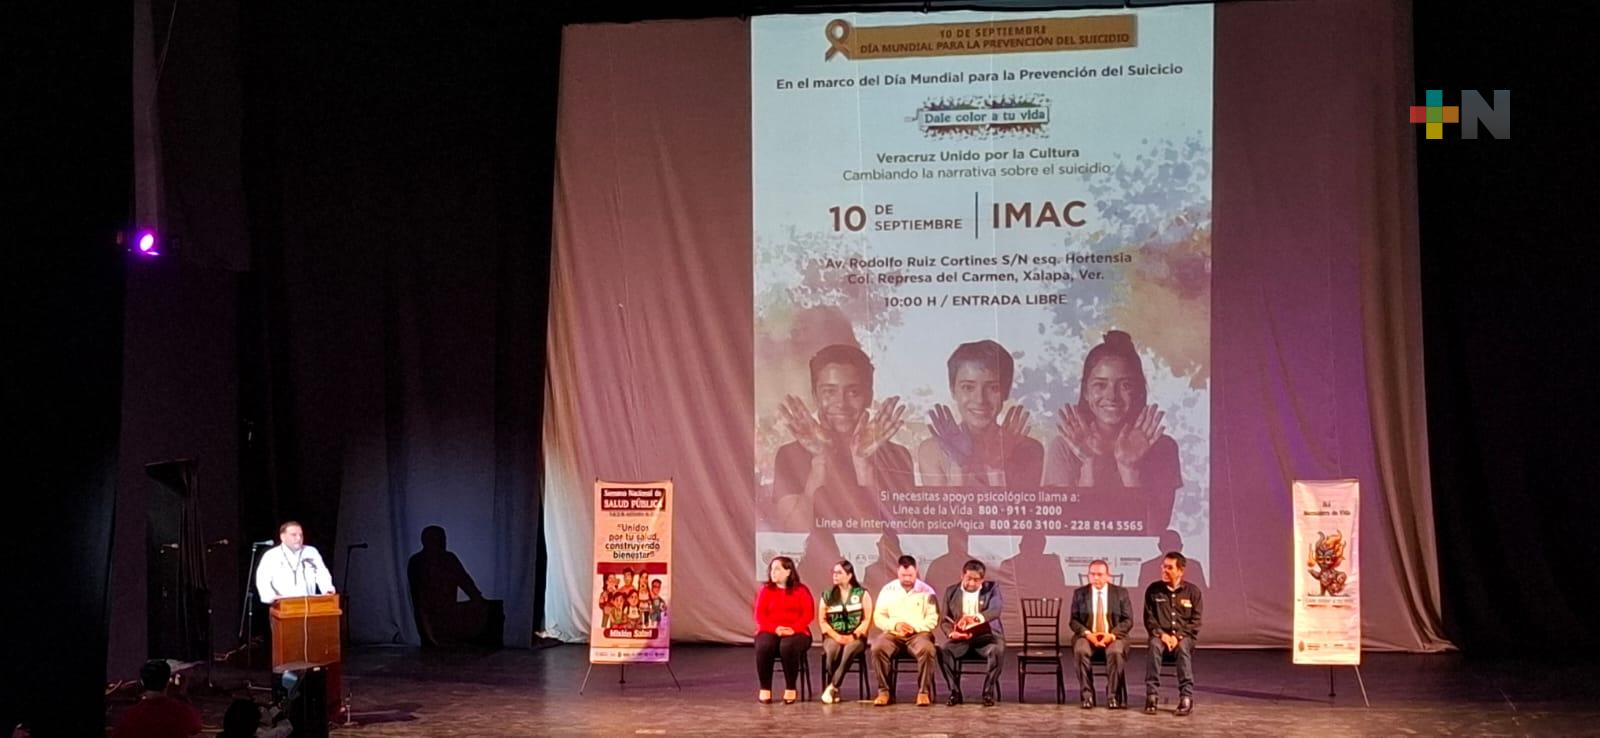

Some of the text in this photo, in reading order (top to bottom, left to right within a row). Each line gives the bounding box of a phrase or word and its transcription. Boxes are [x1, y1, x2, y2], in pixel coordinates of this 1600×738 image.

[940, 25, 1046, 38] 10 DE SEPTIEMBRE
[860, 33, 1130, 54] DÍA MUNDIAL PARA LA PREVENCIÓN DEL SUICIDIO
[776, 78, 793, 90] En
[797, 78, 809, 89] el
[813, 79, 855, 88] marco
[859, 75, 880, 87] del
[884, 74, 906, 86] Día
[911, 72, 964, 84] Mundial
[968, 74, 998, 84] para
[1003, 70, 1015, 81] la
[1020, 66, 1097, 80] Prevención
[1101, 66, 1123, 77] del
[925, 113, 951, 124] Dale
[955, 112, 987, 122] color
[1003, 110, 1016, 120] tu
[1020, 109, 1046, 120] vida
[876, 147, 1080, 164] Veracruz Unido por la Cultura
[842, 162, 1111, 181] Cambiando la narrativa sobre el suicidio
[874, 204, 894, 215] DE
[992, 200, 1087, 229] IMAC
[829, 205, 867, 232] 10
[874, 218, 963, 232] SEPTIEMBRE
[826, 252, 1132, 269] Av. Rodolfo Ruiz Cortines S/N esq. Hortensia
[847, 270, 1104, 286] Col. Represa del Carmen, Xalapa, Ver.
[884, 294, 1068, 308] 10:00 H / ENTRADA LIBRE
[880, 490, 1080, 504] Si necesitas apoyo psicológico llama a:
[923, 504, 936, 515] de
[938, 504, 948, 515] la
[950, 504, 973, 515] Vida
[979, 506, 998, 515] 800
[1006, 506, 1026, 515] 911
[1035, 506, 1062, 516] 2000
[815, 518, 842, 528] Línea
[846, 518, 858, 528] de
[990, 520, 1010, 530] 800
[1012, 520, 1032, 530] 260
[1034, 520, 1062, 530] 3100
[1070, 520, 1090, 530] 228
[1094, 520, 1113, 530] 814
[1116, 520, 1143, 530] 5565
[608, 534, 622, 542] por
